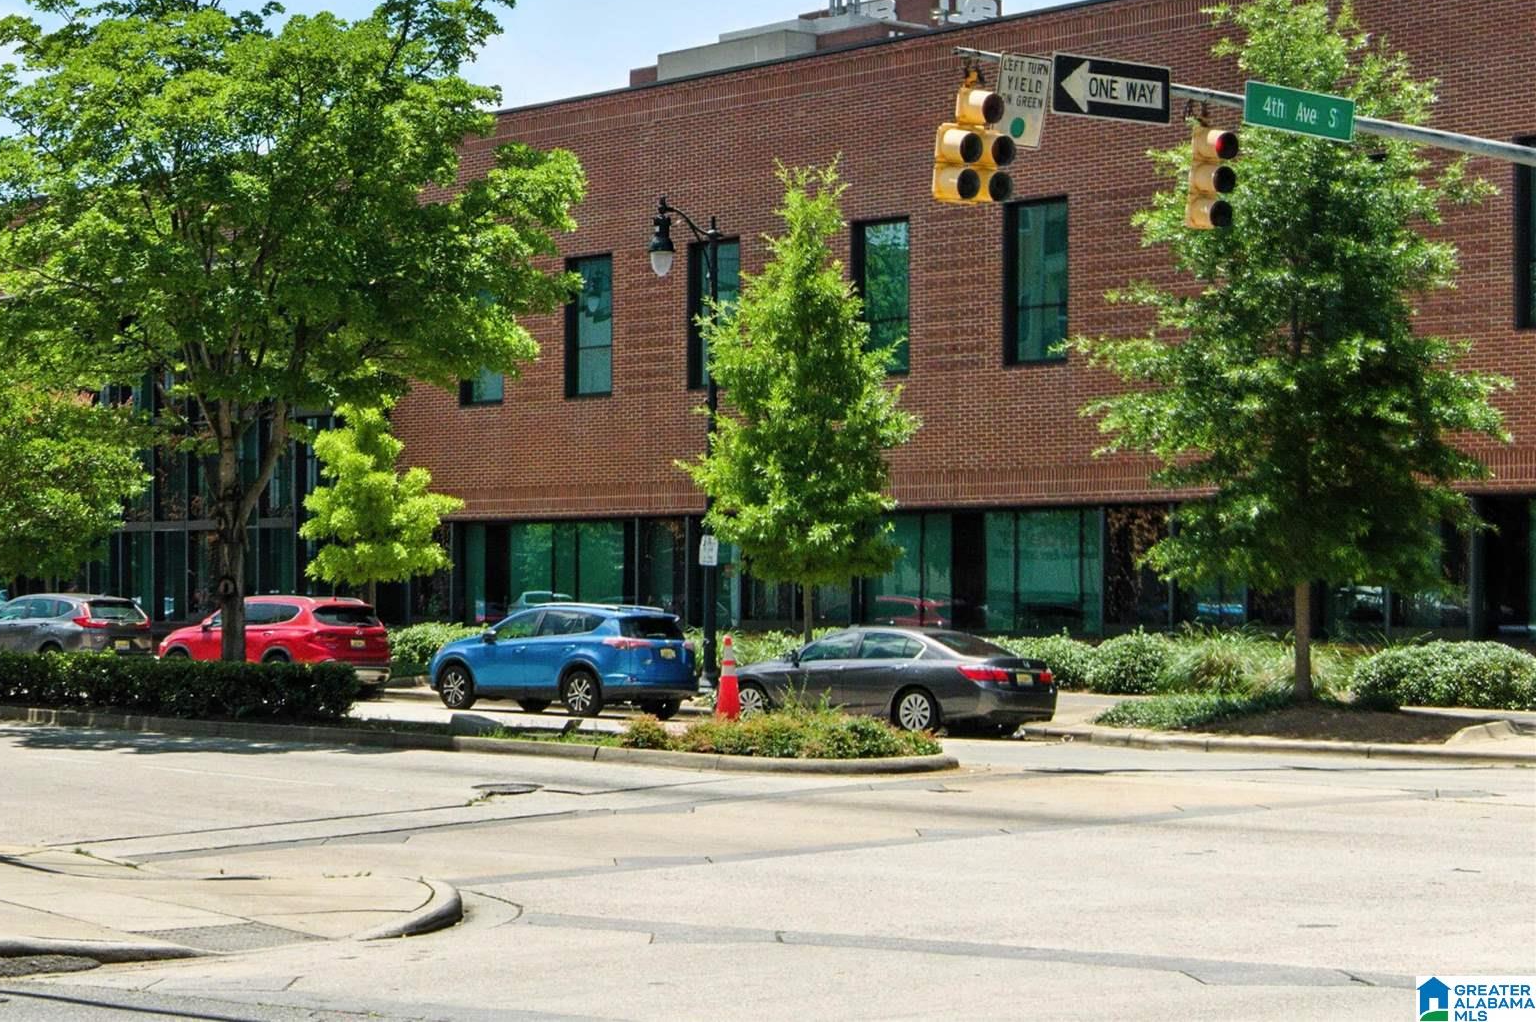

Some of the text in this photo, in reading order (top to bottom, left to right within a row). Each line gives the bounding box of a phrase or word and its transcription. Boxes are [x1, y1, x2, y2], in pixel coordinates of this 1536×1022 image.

[1003, 58, 1049, 76] LEFT TURN
[1007, 77, 1043, 95] YIELD
[1088, 76, 1158, 104] ONE WAY
[1016, 95, 1043, 109] GREEN
[1262, 96, 1338, 128] 4th Ave S
